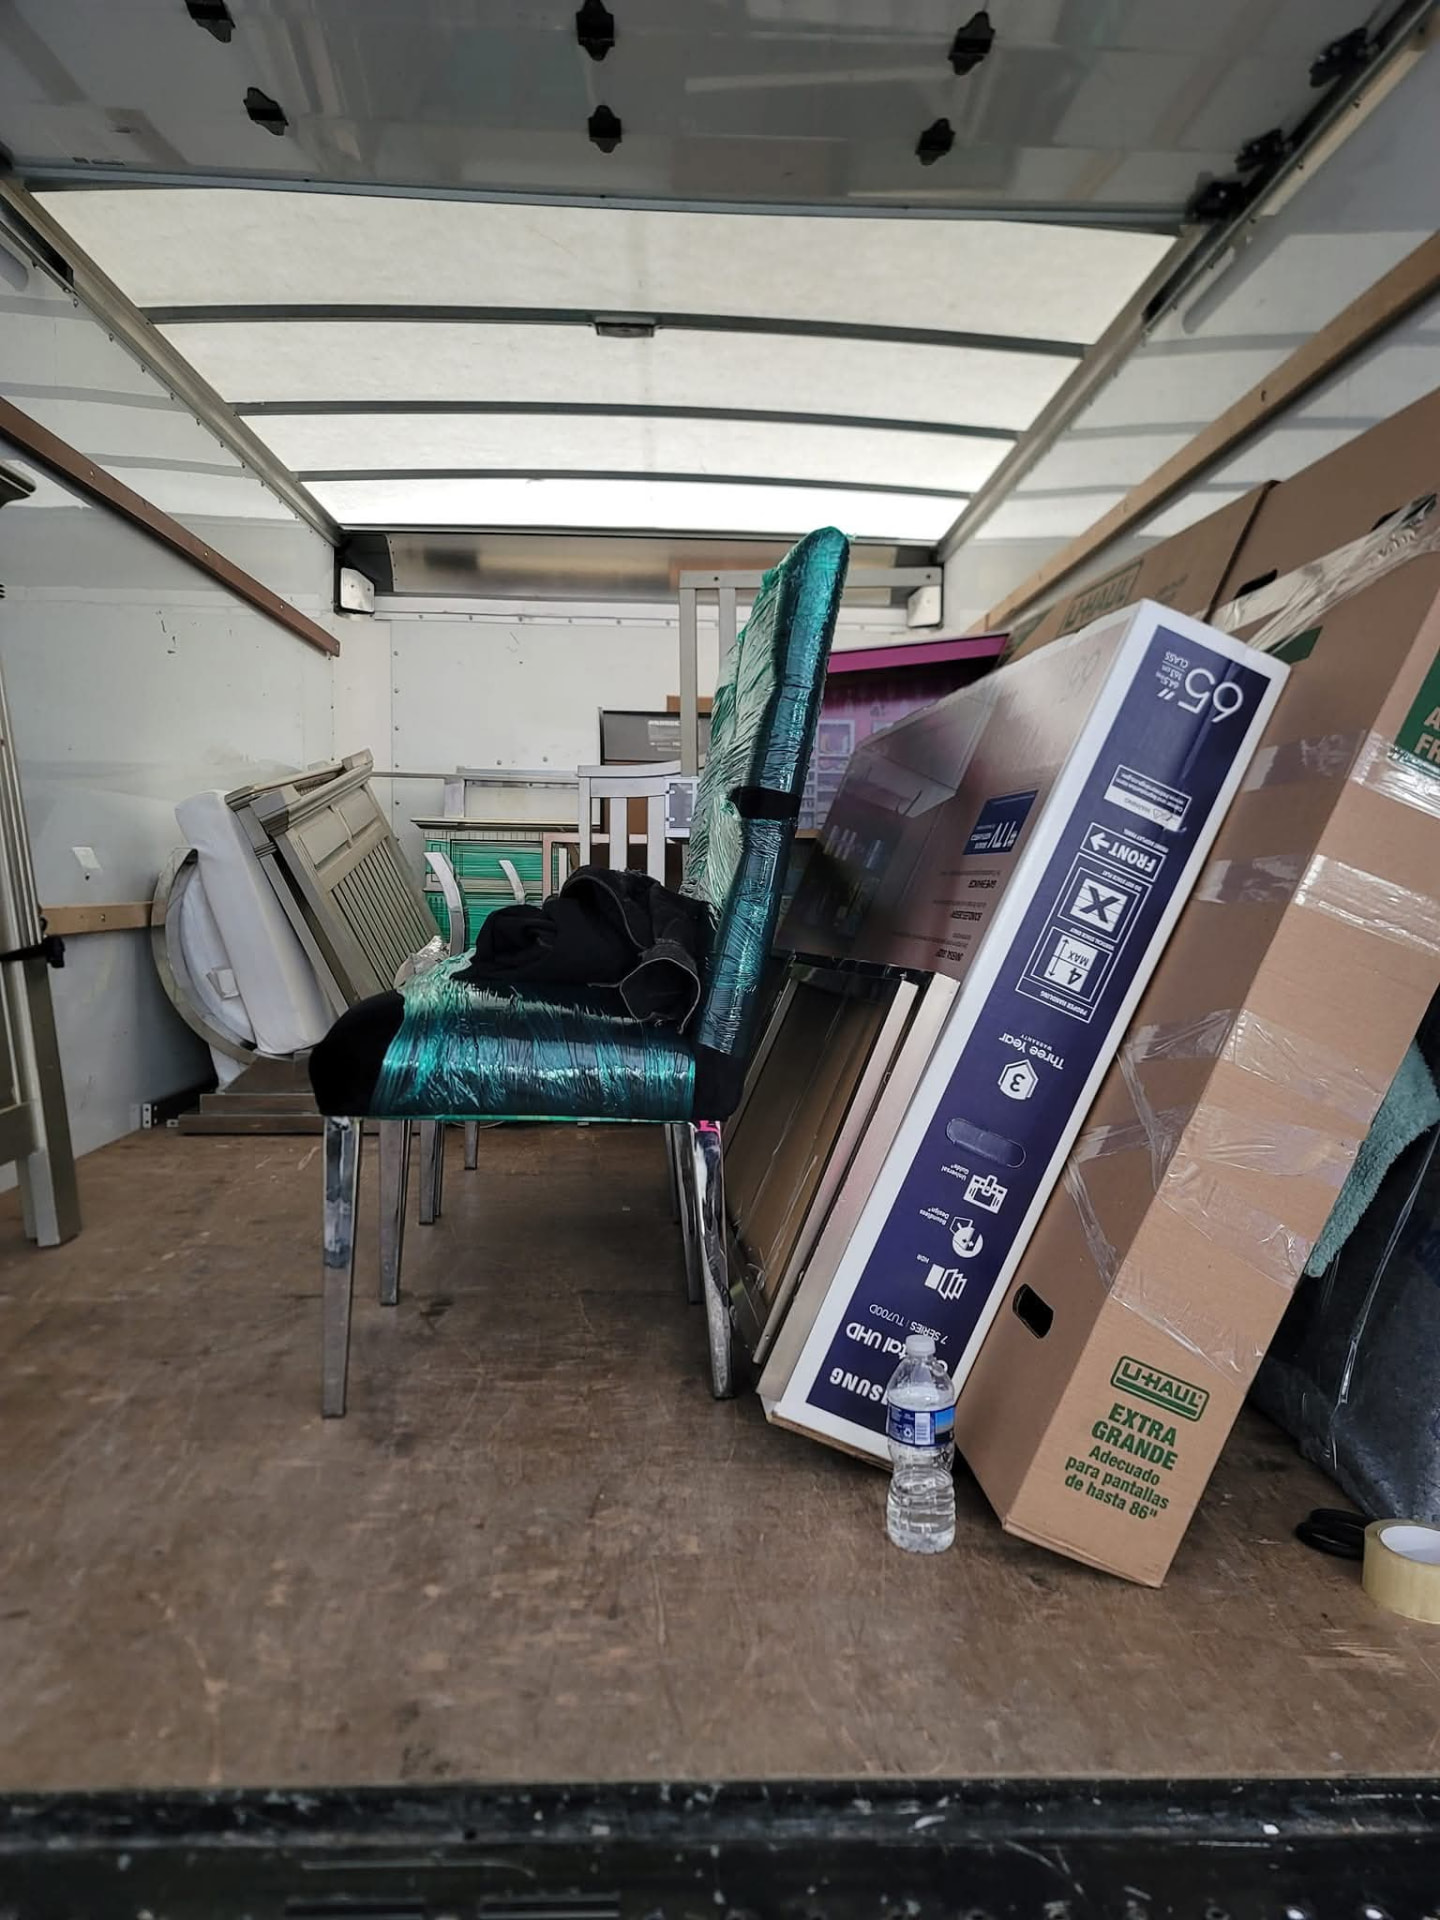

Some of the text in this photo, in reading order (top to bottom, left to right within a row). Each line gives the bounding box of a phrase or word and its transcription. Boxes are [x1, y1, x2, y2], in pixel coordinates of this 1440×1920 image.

[1164, 651, 1189, 669] CLASS
[1108, 842, 1156, 873] FRONT
[1067, 950, 1089, 967] MAX
[1067, 967, 1082, 985] 4
[1040, 990, 1088, 1016] PROPER HANDLING
[998, 1032, 1064, 1070] Three Year
[1020, 1034, 1053, 1051] WARRANTY
[1010, 1073, 1026, 1092] 3
[941, 1165, 967, 1181] Universal
[919, 1209, 946, 1226] Boundless
[917, 1254, 930, 1263] HDR
[845, 1322, 882, 1349] UHD
[909, 1321, 941, 1342] SERIES
[940, 1335, 949, 1345] 7
[1108, 1402, 1177, 1447] EXTRA
[1091, 1420, 1178, 1471] GRANDE
[1088, 1445, 1161, 1486] Adecuado
[1065, 1456, 1170, 1510] para pantallas
[1065, 1474, 1158, 1520] de hasta 86"
